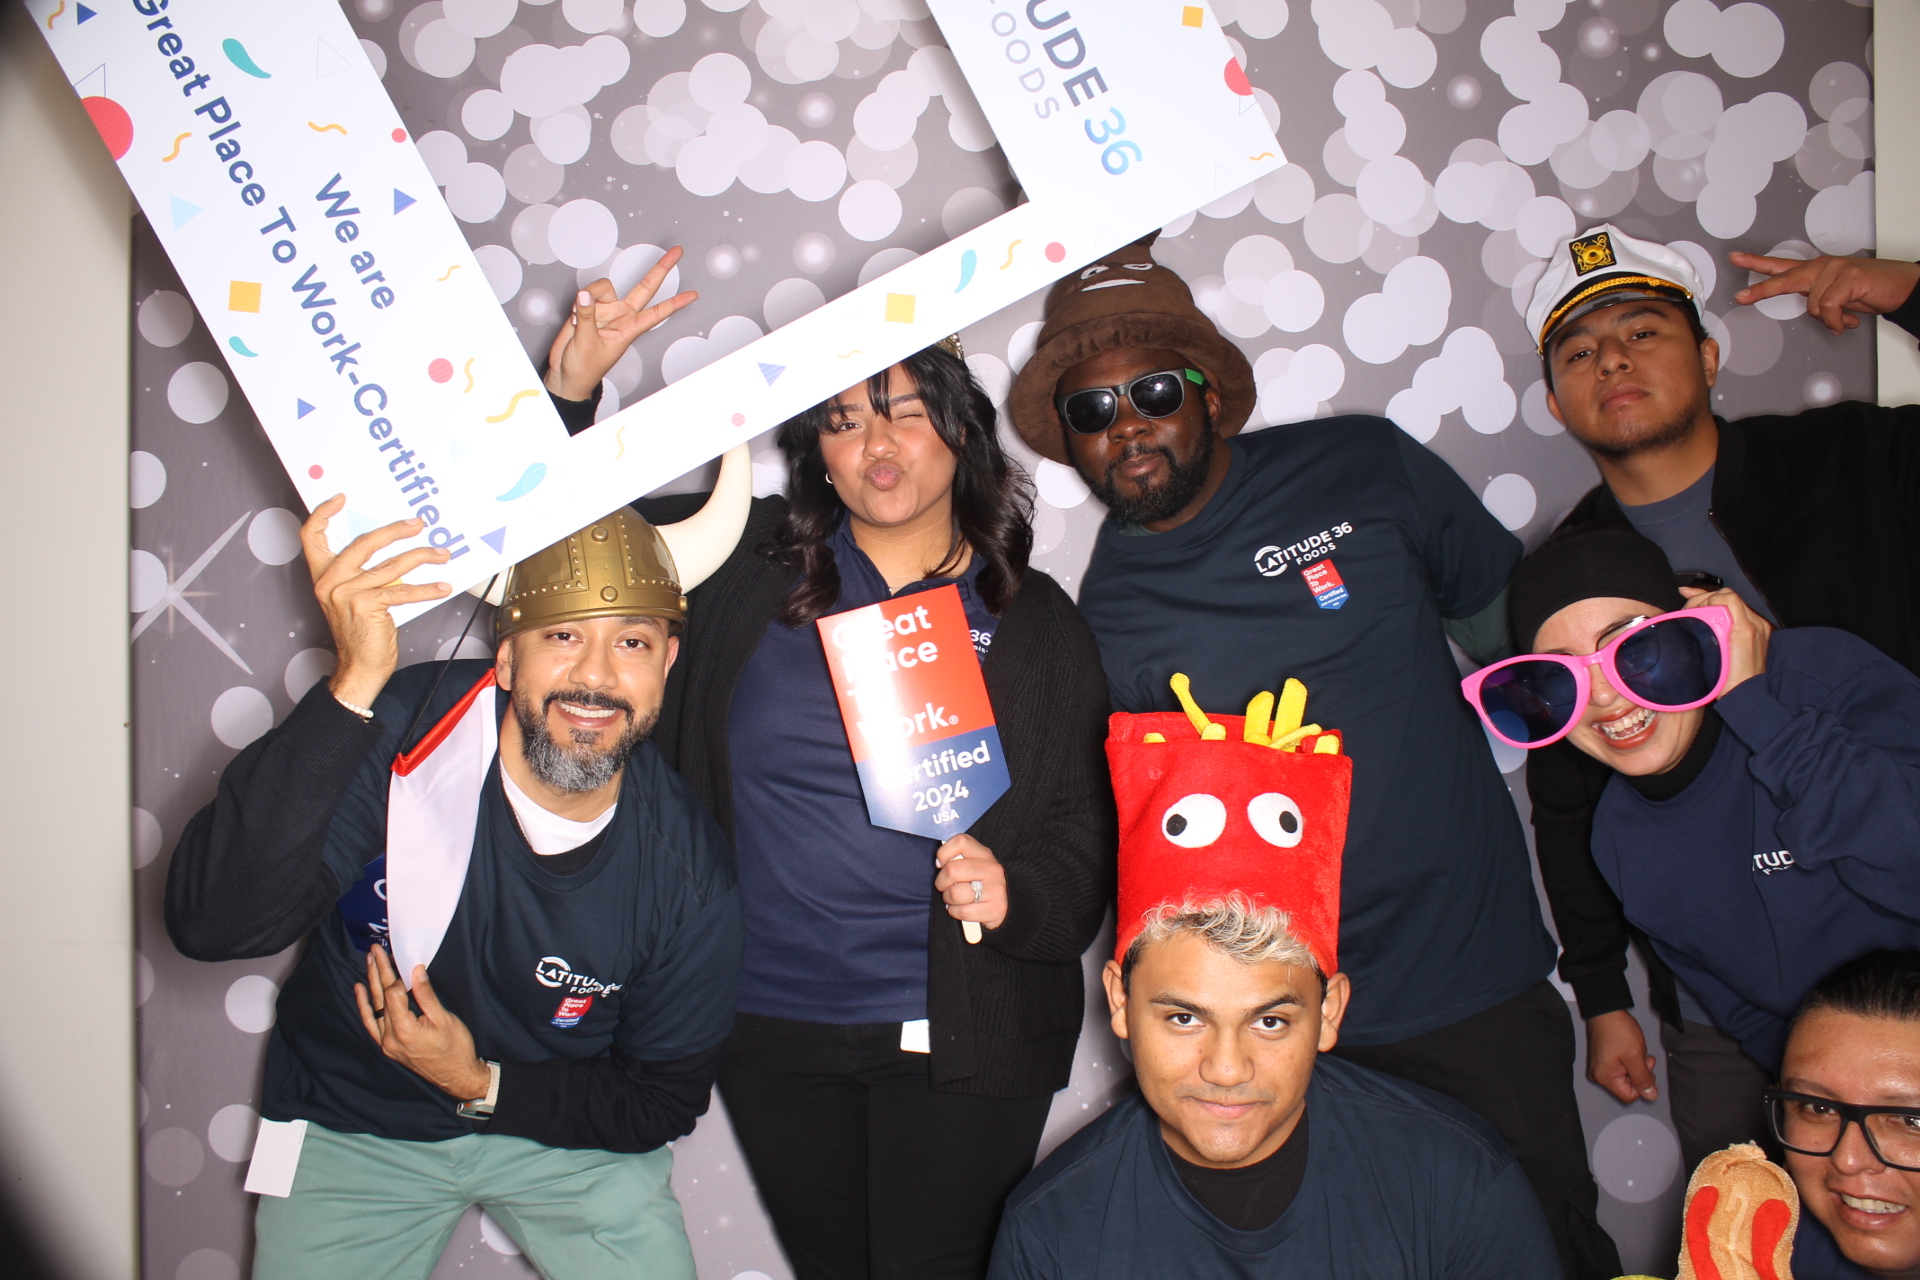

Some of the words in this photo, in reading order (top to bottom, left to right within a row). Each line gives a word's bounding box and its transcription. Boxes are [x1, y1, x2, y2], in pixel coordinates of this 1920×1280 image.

[990, 0, 1060, 119] OODS
[1084, 106, 1142, 175] 36
[194, 96, 266, 206] Place
[259, 206, 297, 264] To
[315, 173, 361, 243] We
[350, 251, 395, 310] are
[1256, 530, 1332, 574] LATITUDE
[1331, 521, 1353, 538] 36
[1296, 542, 1336, 565] FOODS
[1303, 564, 1325, 576] Great
[1306, 569, 1328, 582] Place
[832, 605, 932, 650] eat
[969, 629, 991, 646] 36
[842, 641, 938, 684] ace
[877, 740, 991, 790] rtified
[912, 779, 969, 812] 2024
[933, 809, 960, 825] USA
[1752, 850, 1794, 871] TUD
